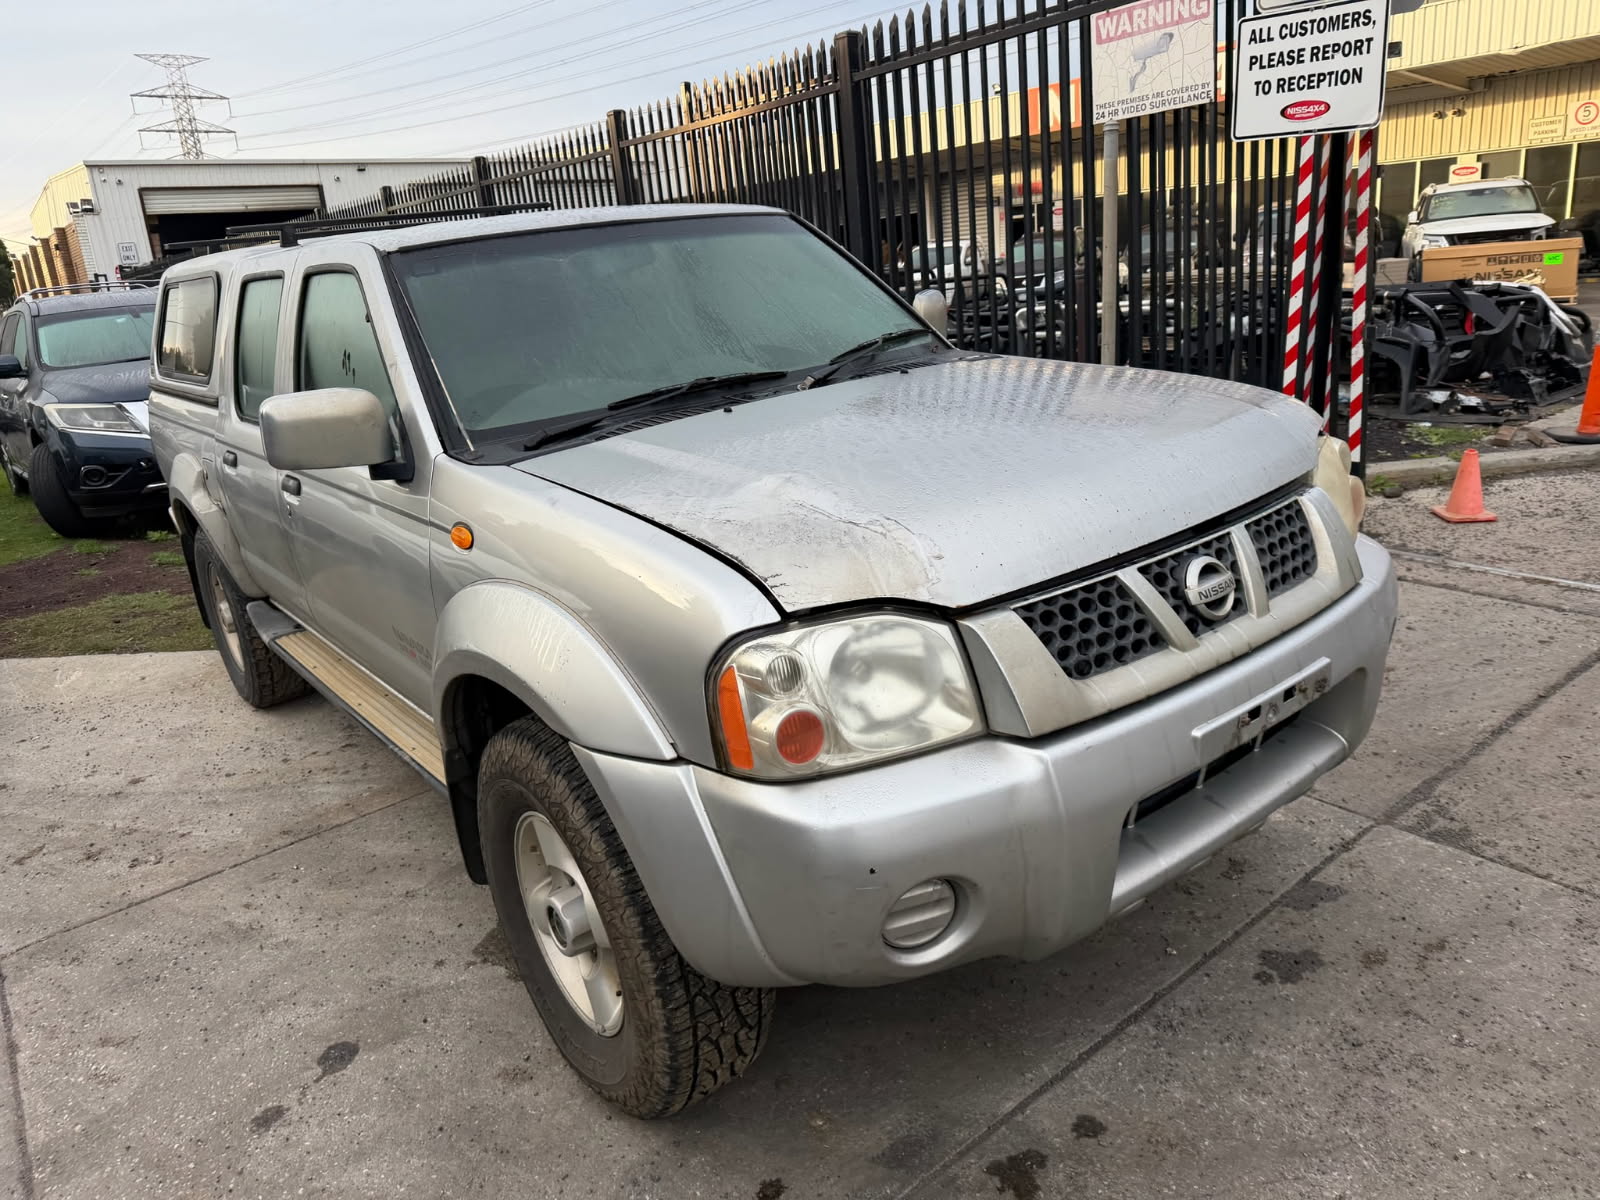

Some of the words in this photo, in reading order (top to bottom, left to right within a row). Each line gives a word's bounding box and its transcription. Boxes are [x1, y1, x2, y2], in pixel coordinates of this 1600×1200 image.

[1098, 0, 1208, 40] WARNING
[1248, 26, 1275, 45] ALL
[1279, 9, 1376, 40] CUSTOMERS,
[1249, 48, 1306, 71] PLEASE
[1310, 37, 1374, 62] REPORT
[1096, 101, 1115, 110] THESE
[1117, 94, 1150, 107] PREMISES
[1152, 91, 1165, 99] ARE
[1167, 85, 1199, 97] COVERED
[1201, 81, 1211, 90] BY
[1254, 80, 1272, 96] TO
[1276, 67, 1363, 94] RECEPTION
[1095, 111, 1106, 120] 24
[1108, 106, 1119, 118] HR
[1121, 103, 1147, 115] VIDEO
[1149, 90, 1212, 109] SURVEILANCE
[1583, 105, 1591, 117] 5
[1530, 119, 1562, 128] CUSTOMER
[1198, 577, 1234, 600] NISSAN
